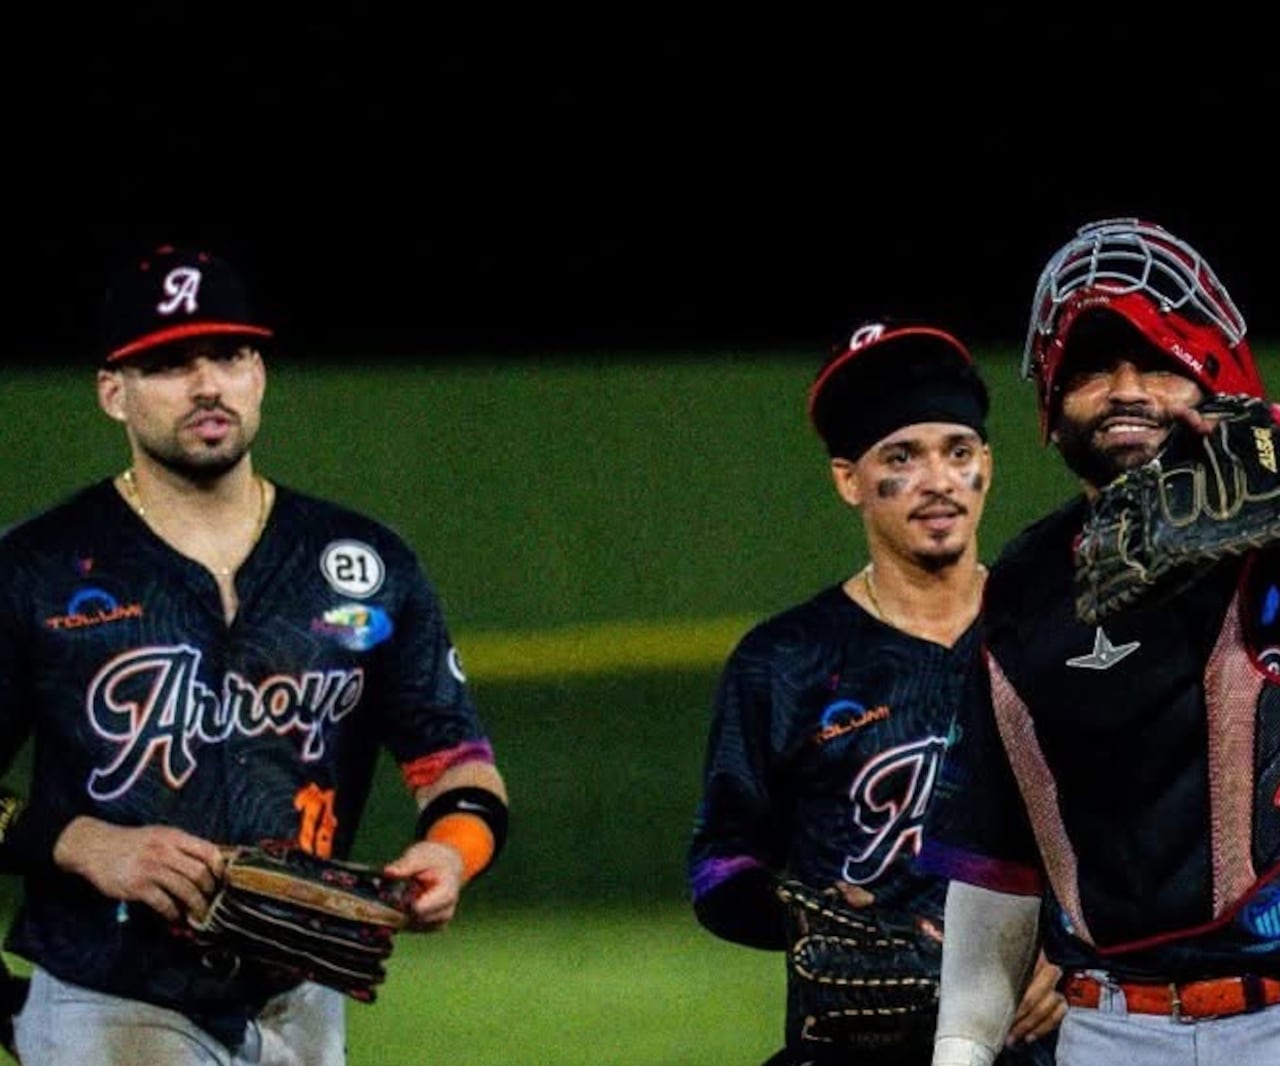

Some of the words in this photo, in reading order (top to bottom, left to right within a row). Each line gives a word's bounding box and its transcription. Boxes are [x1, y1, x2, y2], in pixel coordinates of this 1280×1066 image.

[157, 267, 201, 314] A
[335, 554, 369, 583] 21
[87, 644, 364, 801] Arroyo
